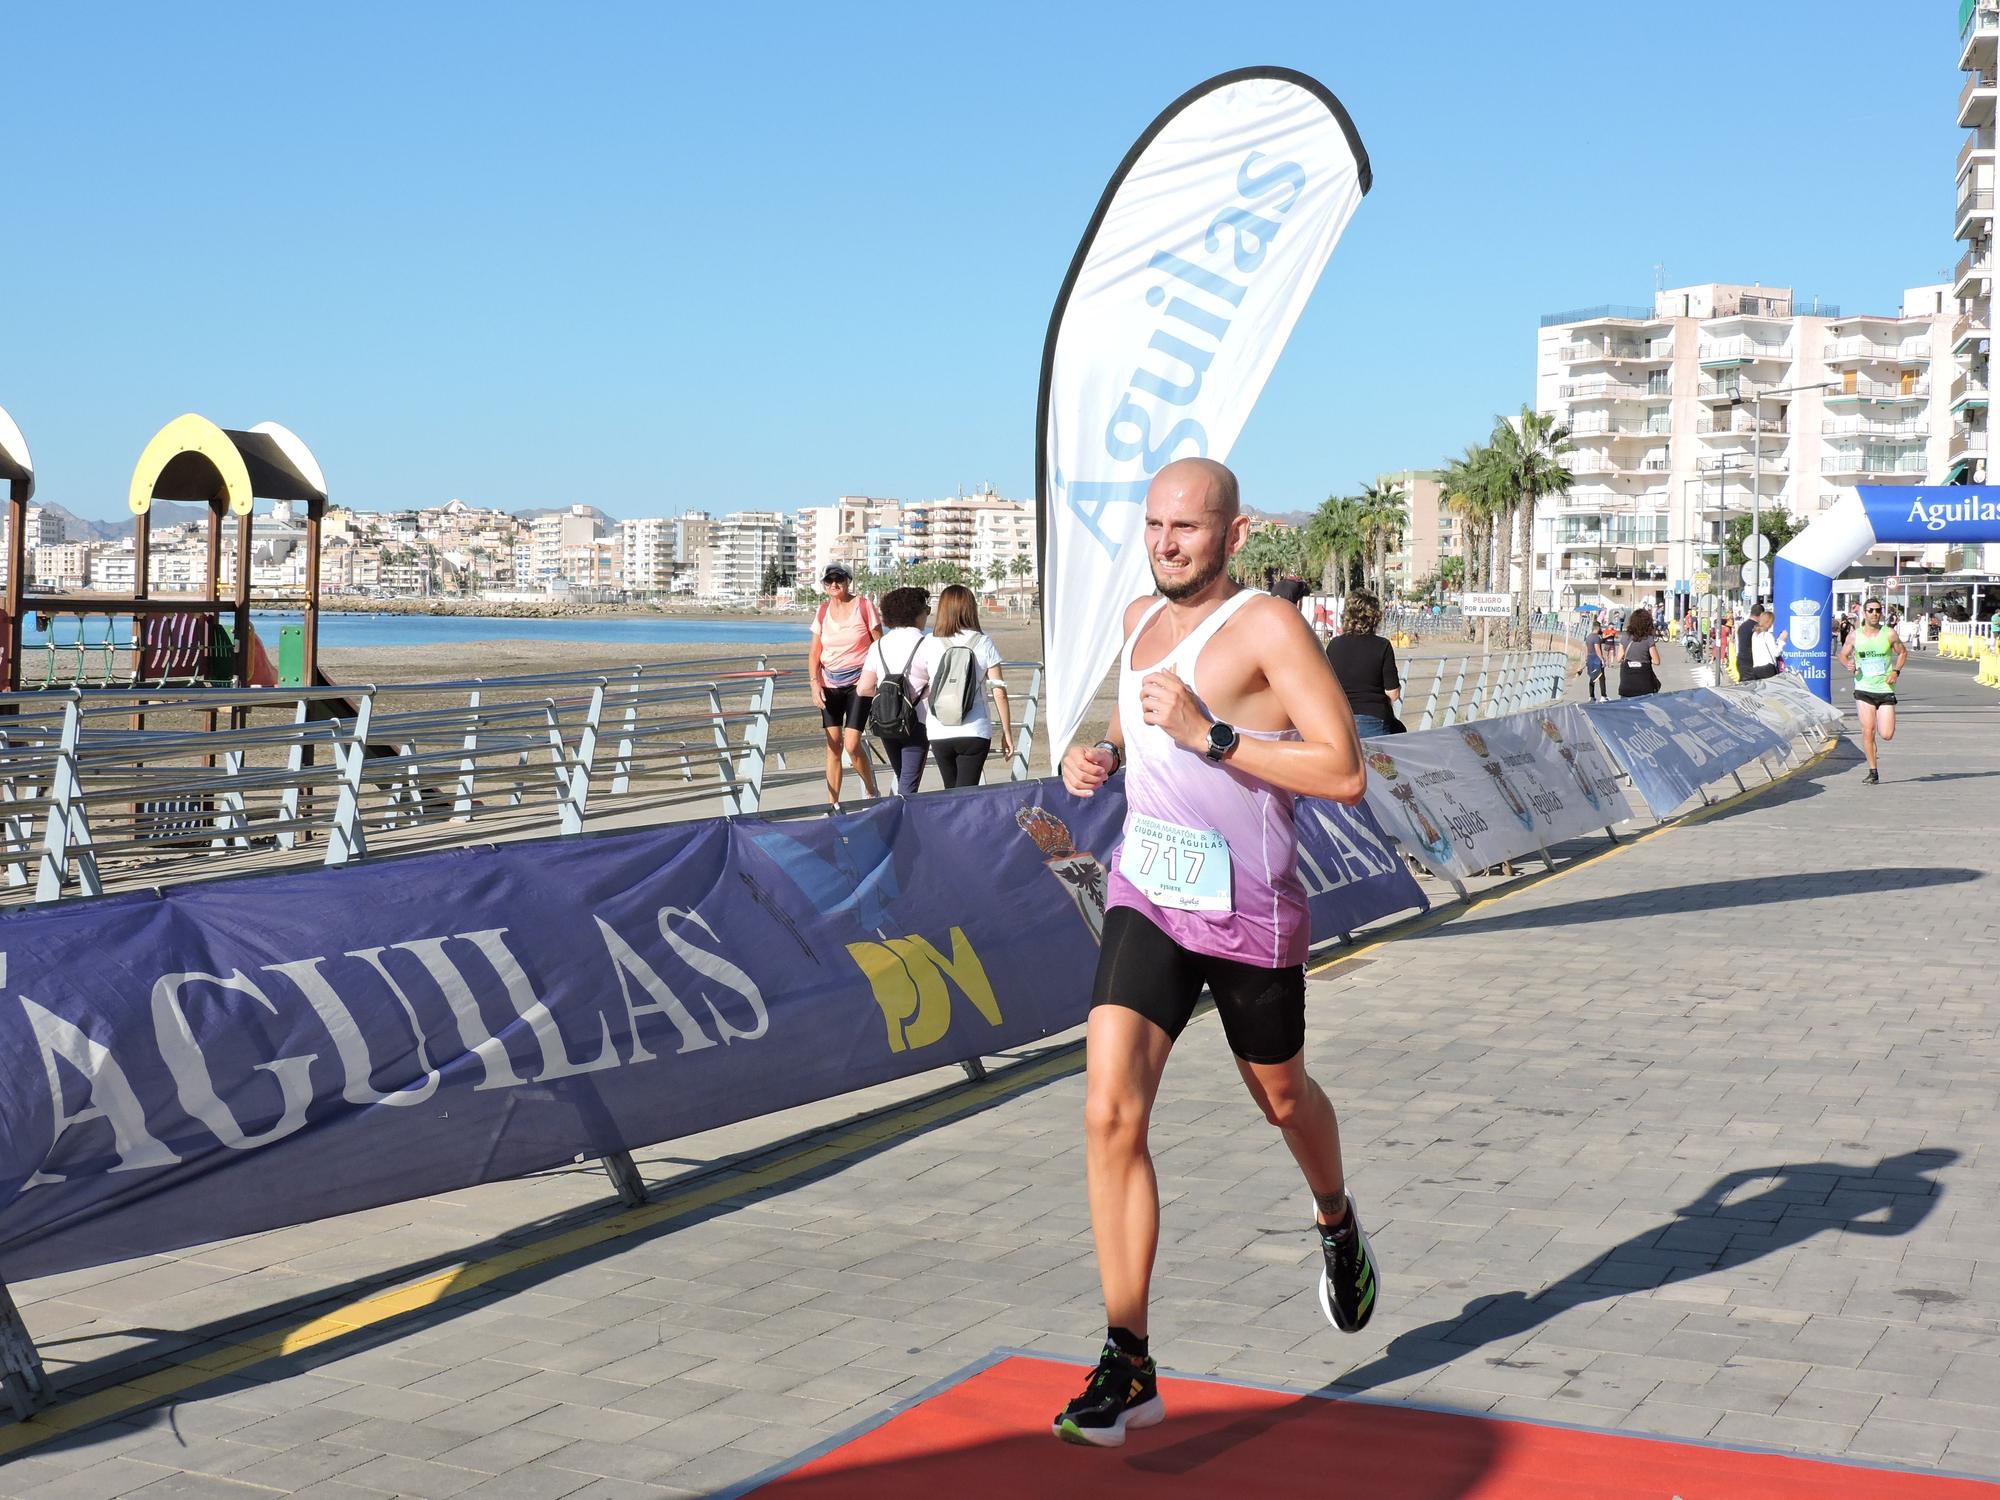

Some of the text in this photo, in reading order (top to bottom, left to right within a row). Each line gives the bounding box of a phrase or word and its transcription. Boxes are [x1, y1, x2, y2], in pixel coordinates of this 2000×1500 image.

[1054, 150, 1307, 562] Águilas
[1473, 596, 1502, 604] PELIGRO
[1801, 659, 1811, 667] de
[1134, 825, 1163, 839] CIUDAD
[1166, 834, 1177, 843] DE
[1440, 802, 1489, 850] Águilas
[1139, 839, 1206, 885] 717
